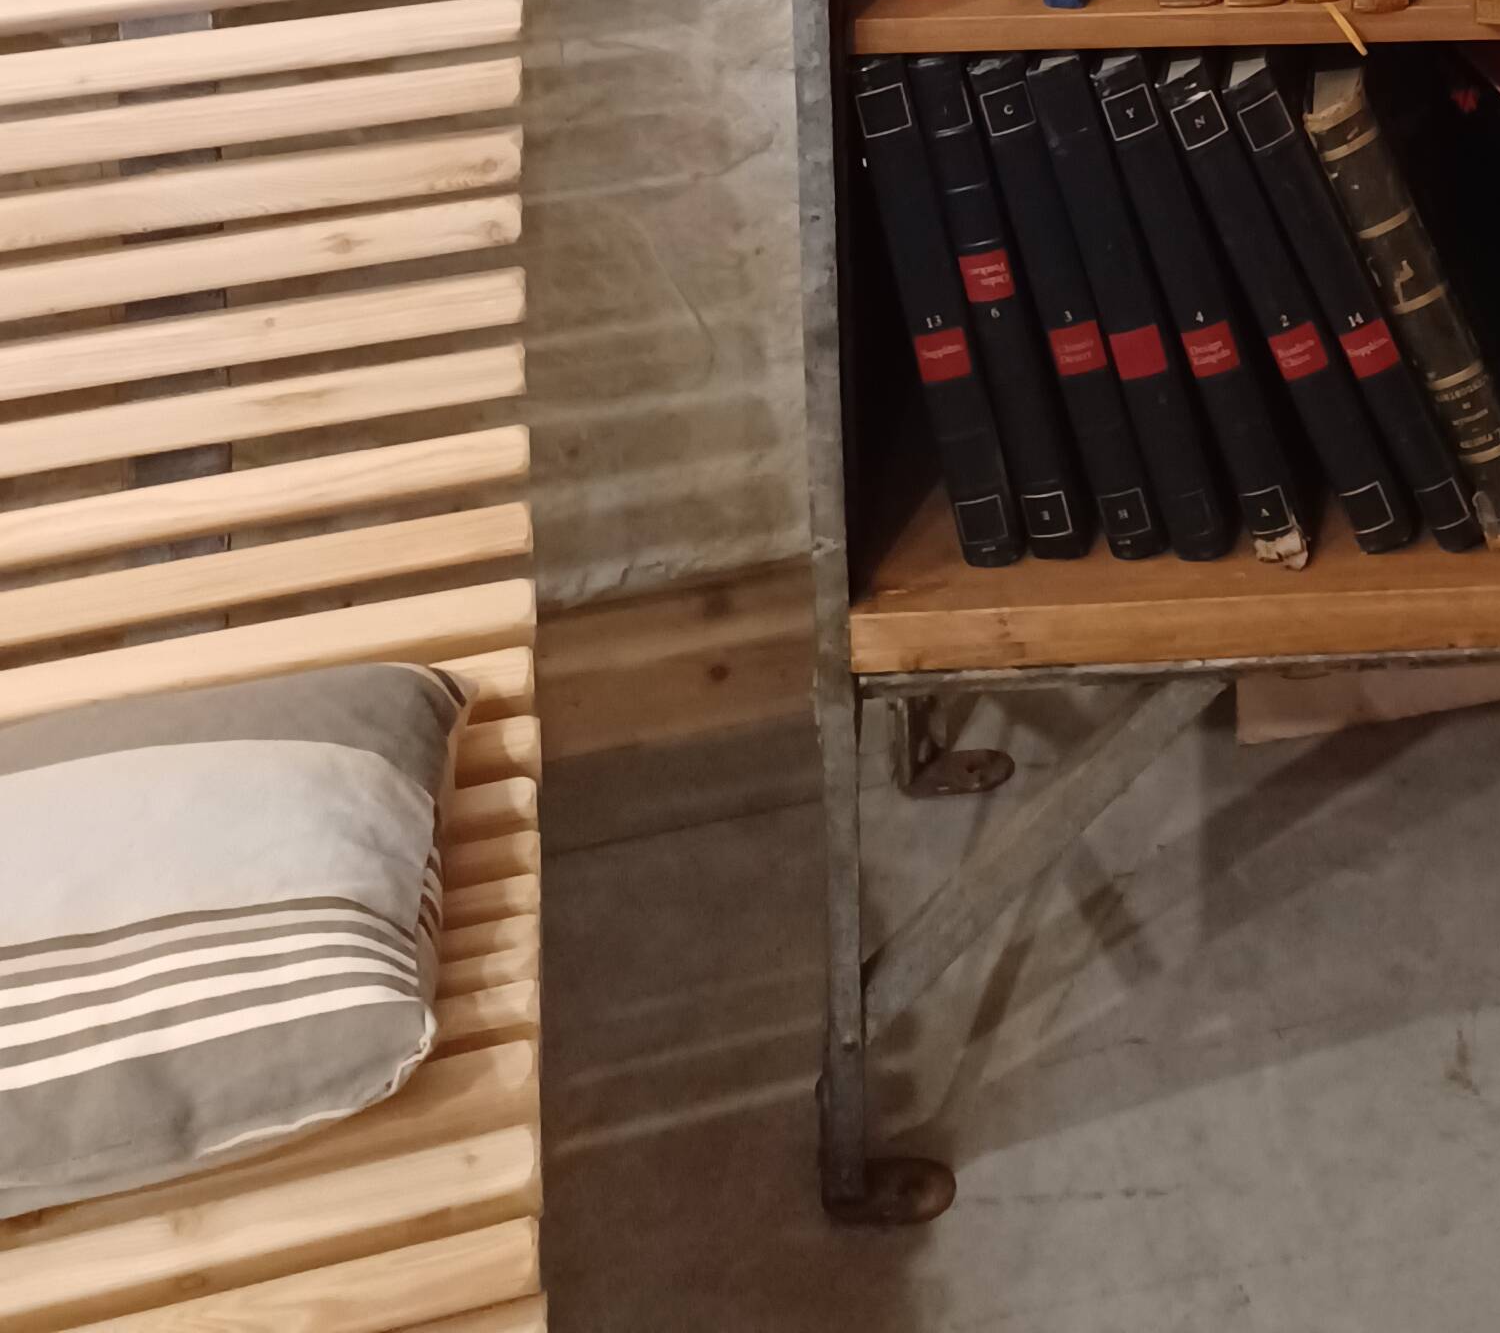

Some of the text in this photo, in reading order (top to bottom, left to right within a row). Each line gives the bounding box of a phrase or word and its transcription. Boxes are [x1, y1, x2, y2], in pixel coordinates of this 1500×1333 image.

[1003, 103, 1014, 116] C
[1124, 106, 1137, 120] Y
[926, 314, 943, 329] 13
[1064, 310, 1074, 323] 3
[1194, 310, 1205, 324] 4
[1279, 314, 1290, 328] 2
[1347, 312, 1365, 329] 14
